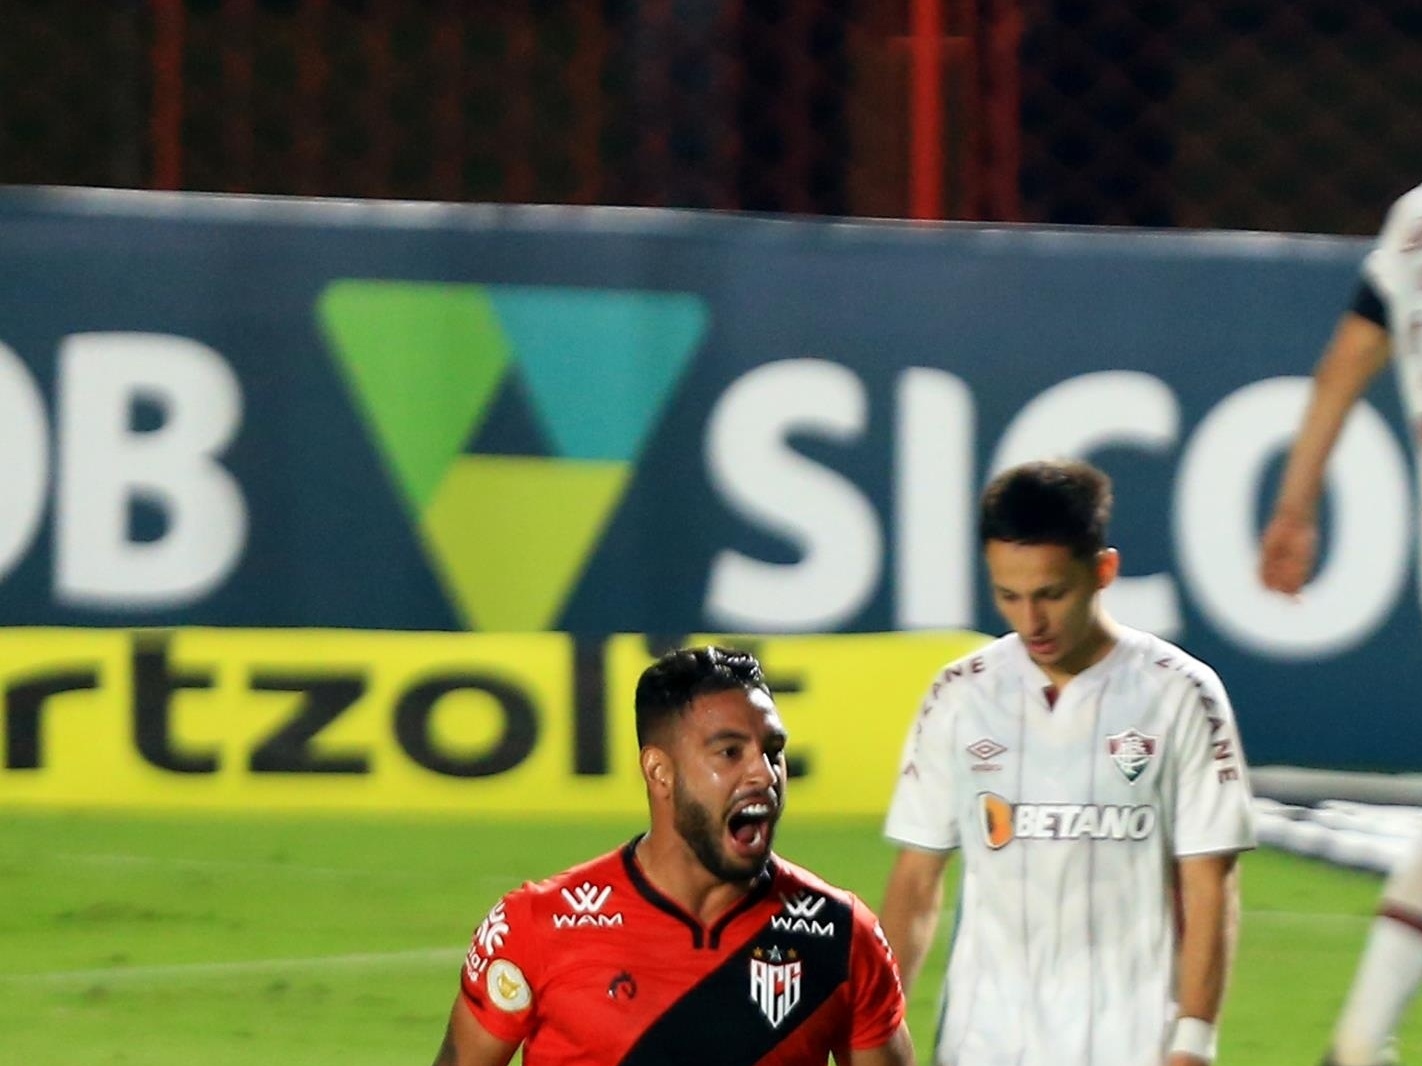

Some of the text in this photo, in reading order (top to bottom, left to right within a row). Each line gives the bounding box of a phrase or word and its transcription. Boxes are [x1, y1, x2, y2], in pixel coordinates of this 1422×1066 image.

[0, 328, 249, 612] B
[1014, 802, 1157, 841] BETANO
[552, 912, 623, 929] WAM
[770, 914, 835, 937] WAM
